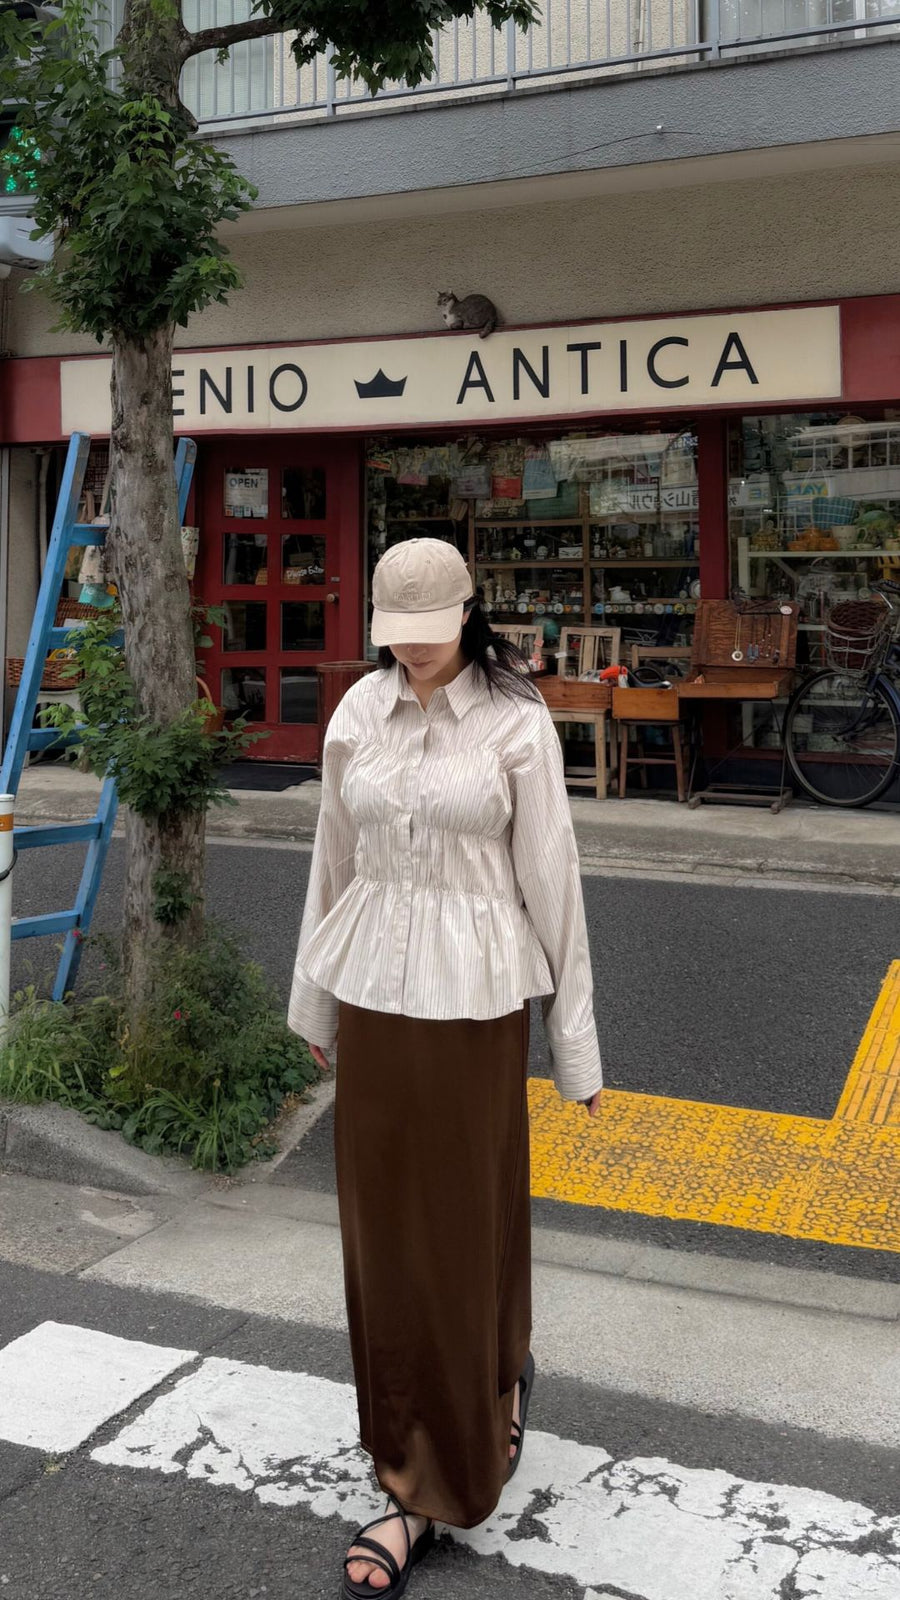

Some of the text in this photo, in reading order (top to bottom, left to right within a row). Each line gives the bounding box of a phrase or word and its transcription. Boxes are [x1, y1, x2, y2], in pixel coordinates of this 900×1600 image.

[171, 332, 760, 416] ENIO ANTICA
[229, 477, 259, 489] OPEN
